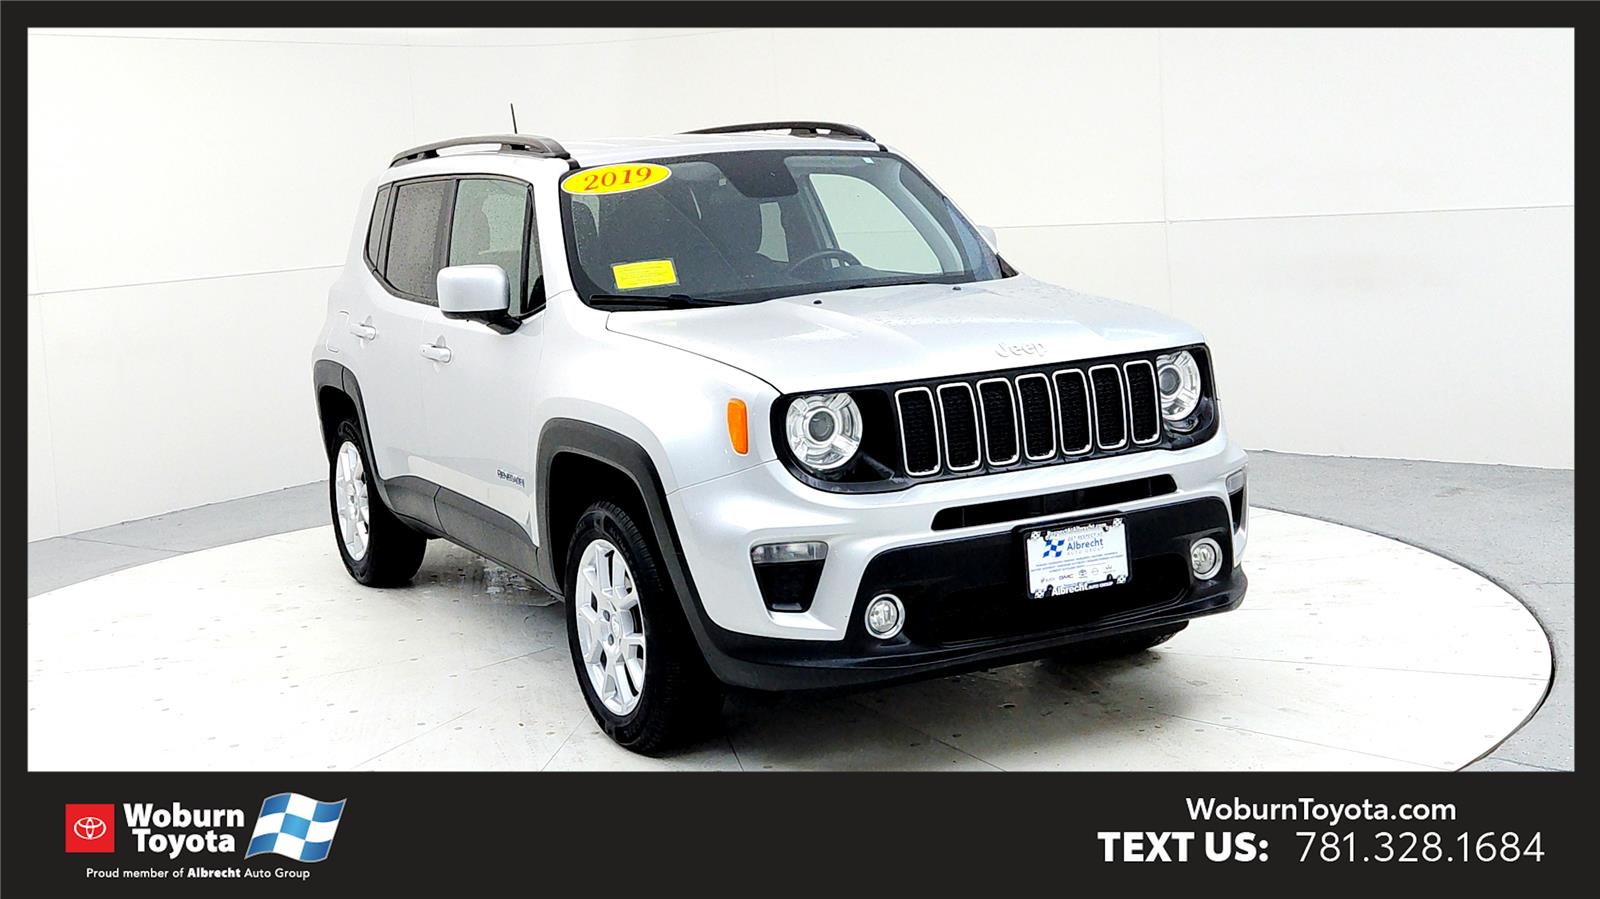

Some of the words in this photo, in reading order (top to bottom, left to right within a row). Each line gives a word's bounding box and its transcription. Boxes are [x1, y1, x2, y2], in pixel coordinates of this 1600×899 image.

[584, 167, 651, 191] 2019
[994, 342, 1047, 358] Jeep
[1067, 538, 1104, 551] Albrecht
[1052, 582, 1088, 596] Albrecht
